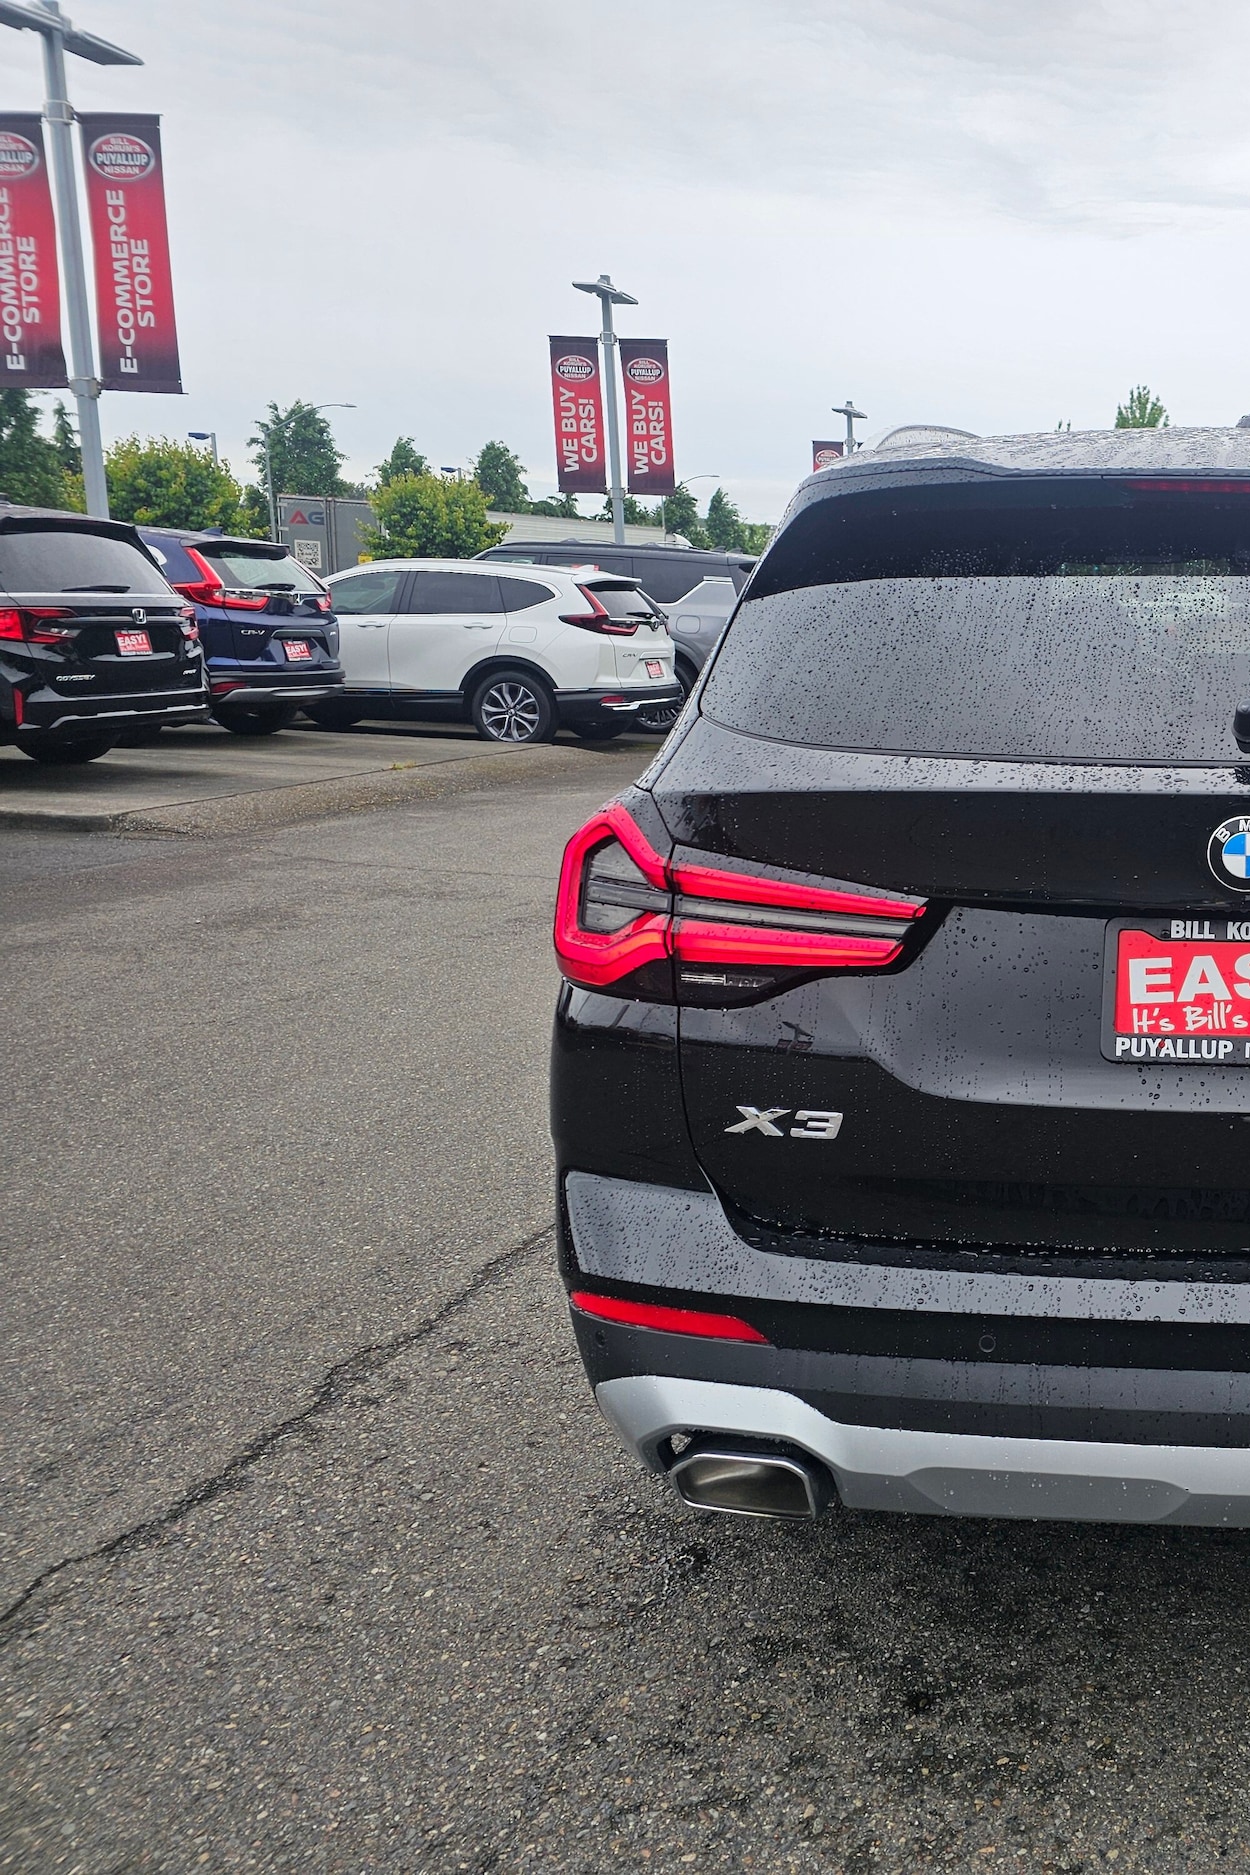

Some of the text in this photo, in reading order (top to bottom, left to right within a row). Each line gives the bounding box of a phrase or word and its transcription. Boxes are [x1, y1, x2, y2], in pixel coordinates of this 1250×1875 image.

[96, 152, 149, 166] PUYALLUP
[104, 166, 140, 174] NISSAN
[16, 236, 40, 323] STORE
[105, 189, 139, 374] E-COMMERCE
[131, 238, 155, 328] STORE
[559, 365, 592, 374] PUYALLUP
[630, 368, 661, 376] PUYALLUP
[559, 386, 577, 432] BUY
[578, 398, 598, 462] CARS!
[631, 389, 649, 475] WE BUY
[648, 401, 667, 465] CARS!
[562, 438, 580, 472] WE
[289, 509, 325, 526] AG
[117, 633, 147, 647] EASY!
[285, 643, 308, 654] EASY!
[1170, 920, 1216, 939] BILL
[1132, 1008, 1175, 1034] It's
[1183, 1001, 1249, 1031] Bill's
[1115, 1037, 1234, 1059] PUYALLUP
[724, 1105, 844, 1140] X3
